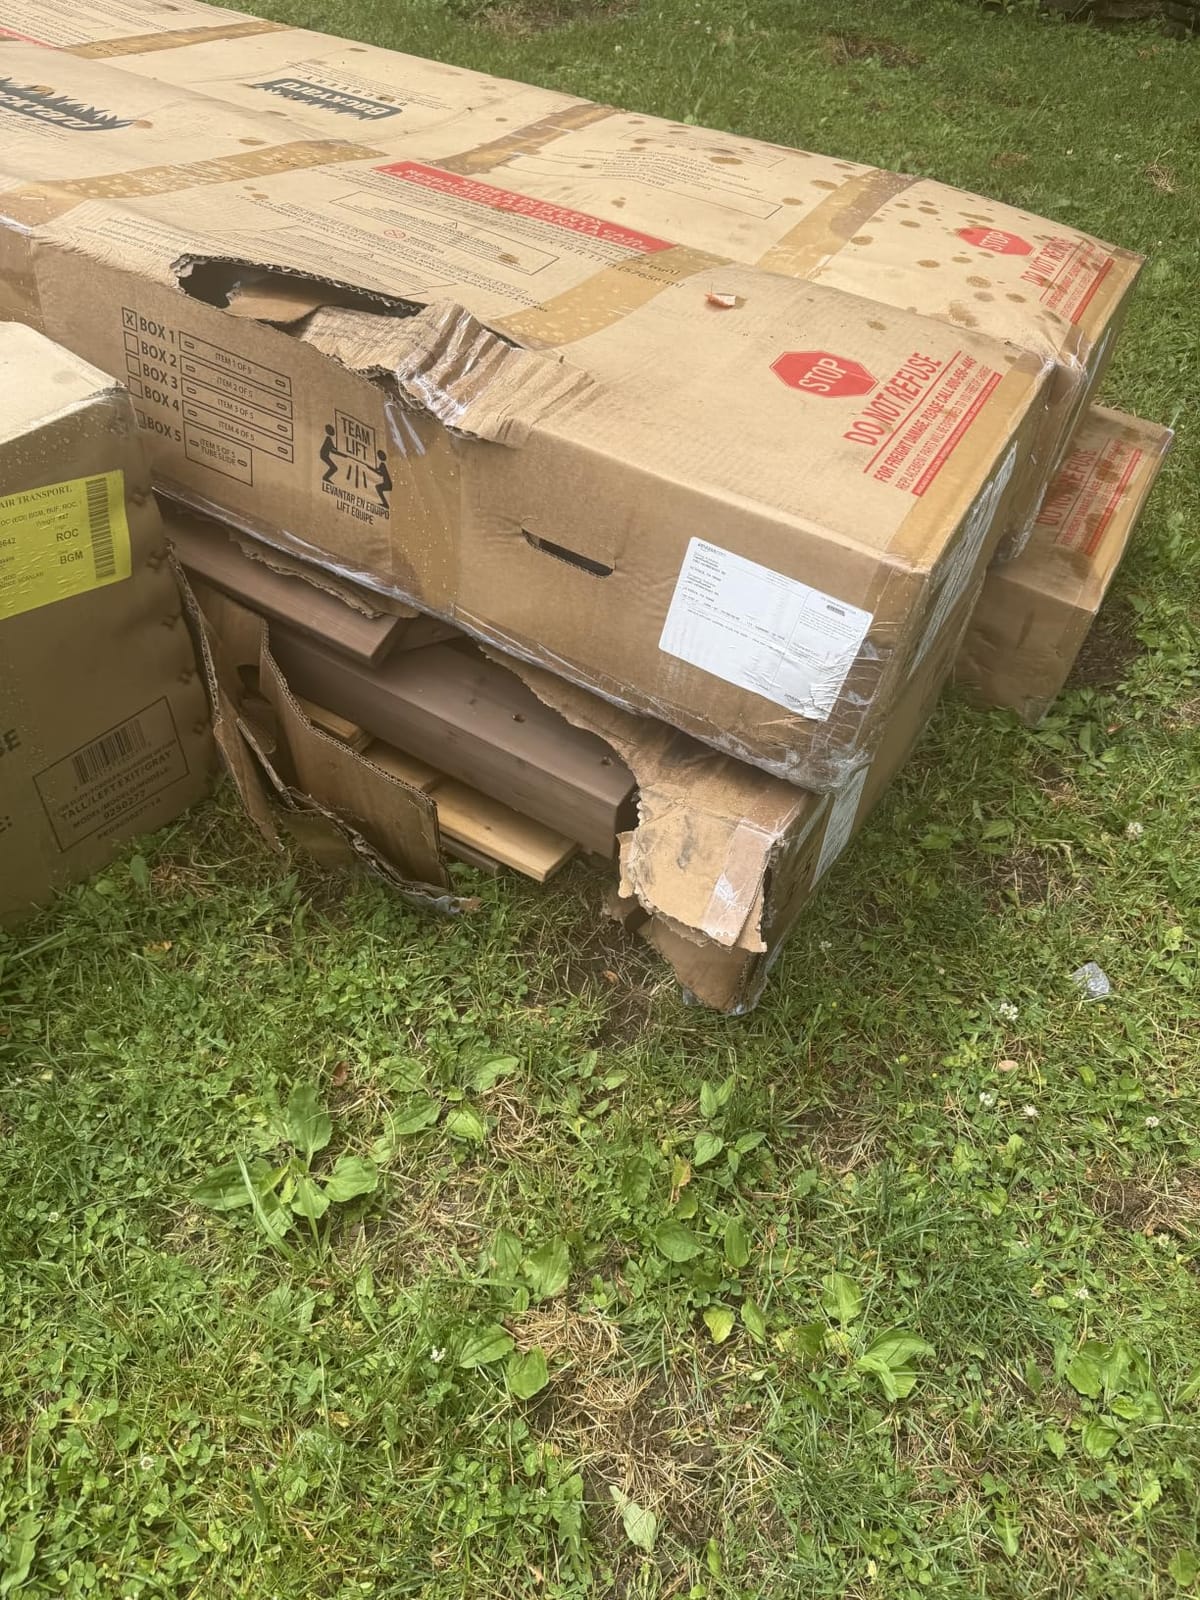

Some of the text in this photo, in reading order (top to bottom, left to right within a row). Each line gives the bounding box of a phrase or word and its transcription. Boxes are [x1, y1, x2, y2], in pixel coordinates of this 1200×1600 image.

[381, 168, 403, 176] LA
[577, 225, 598, 235] LA
[463, 180, 504, 196] SLIDE
[519, 198, 538, 206] IN
[568, 212, 602, 226] BOX
[578, 221, 601, 230] LA
[979, 231, 1009, 251] STOP
[1029, 256, 1058, 277] NOT
[1020, 271, 1047, 288] DO
[140, 317, 175, 344] BOX 1
[141, 340, 177, 368] BOX 2
[215, 352, 231, 366] ITEM
[237, 361, 246, 371] OF
[248, 366, 252, 375] 5
[143, 363, 178, 390] BOX 3
[217, 376, 232, 390] ITEM
[233, 383, 238, 391] 2
[238, 385, 247, 395] OF
[799, 358, 847, 393] STOP
[145, 386, 179, 412] BOX 4
[843, 352, 942, 446] DO NOT REFUSE
[935, 387, 955, 404] CALL
[218, 399, 233, 412] ITEM
[234, 405, 239, 414] 3
[239, 407, 248, 417] OF
[921, 400, 945, 422] PLEASE
[147, 417, 182, 442] BOX 5
[218, 421, 234, 434] ITEM
[235, 427, 239, 435] 4
[240, 429, 249, 439] OF
[341, 417, 370, 446] TEAM
[200, 438, 216, 451] ITEM
[222, 446, 231, 455] OF
[201, 446, 236, 466] TUBE SLIDE
[345, 437, 367, 460] LIFT
[884, 440, 914, 470] FREIGHT
[873, 465, 896, 483] FOR
[895, 453, 927, 490] REPLACEMENT
[920, 440, 938, 457] PARTS
[322, 482, 389, 520] LEVANTAR EN EQUIPO
[336, 499, 374, 525] LIFT EQUIPE
[1036, 511, 1062, 526] DO
[56, 528, 79, 541] ROC
[60, 551, 84, 564] BGM
